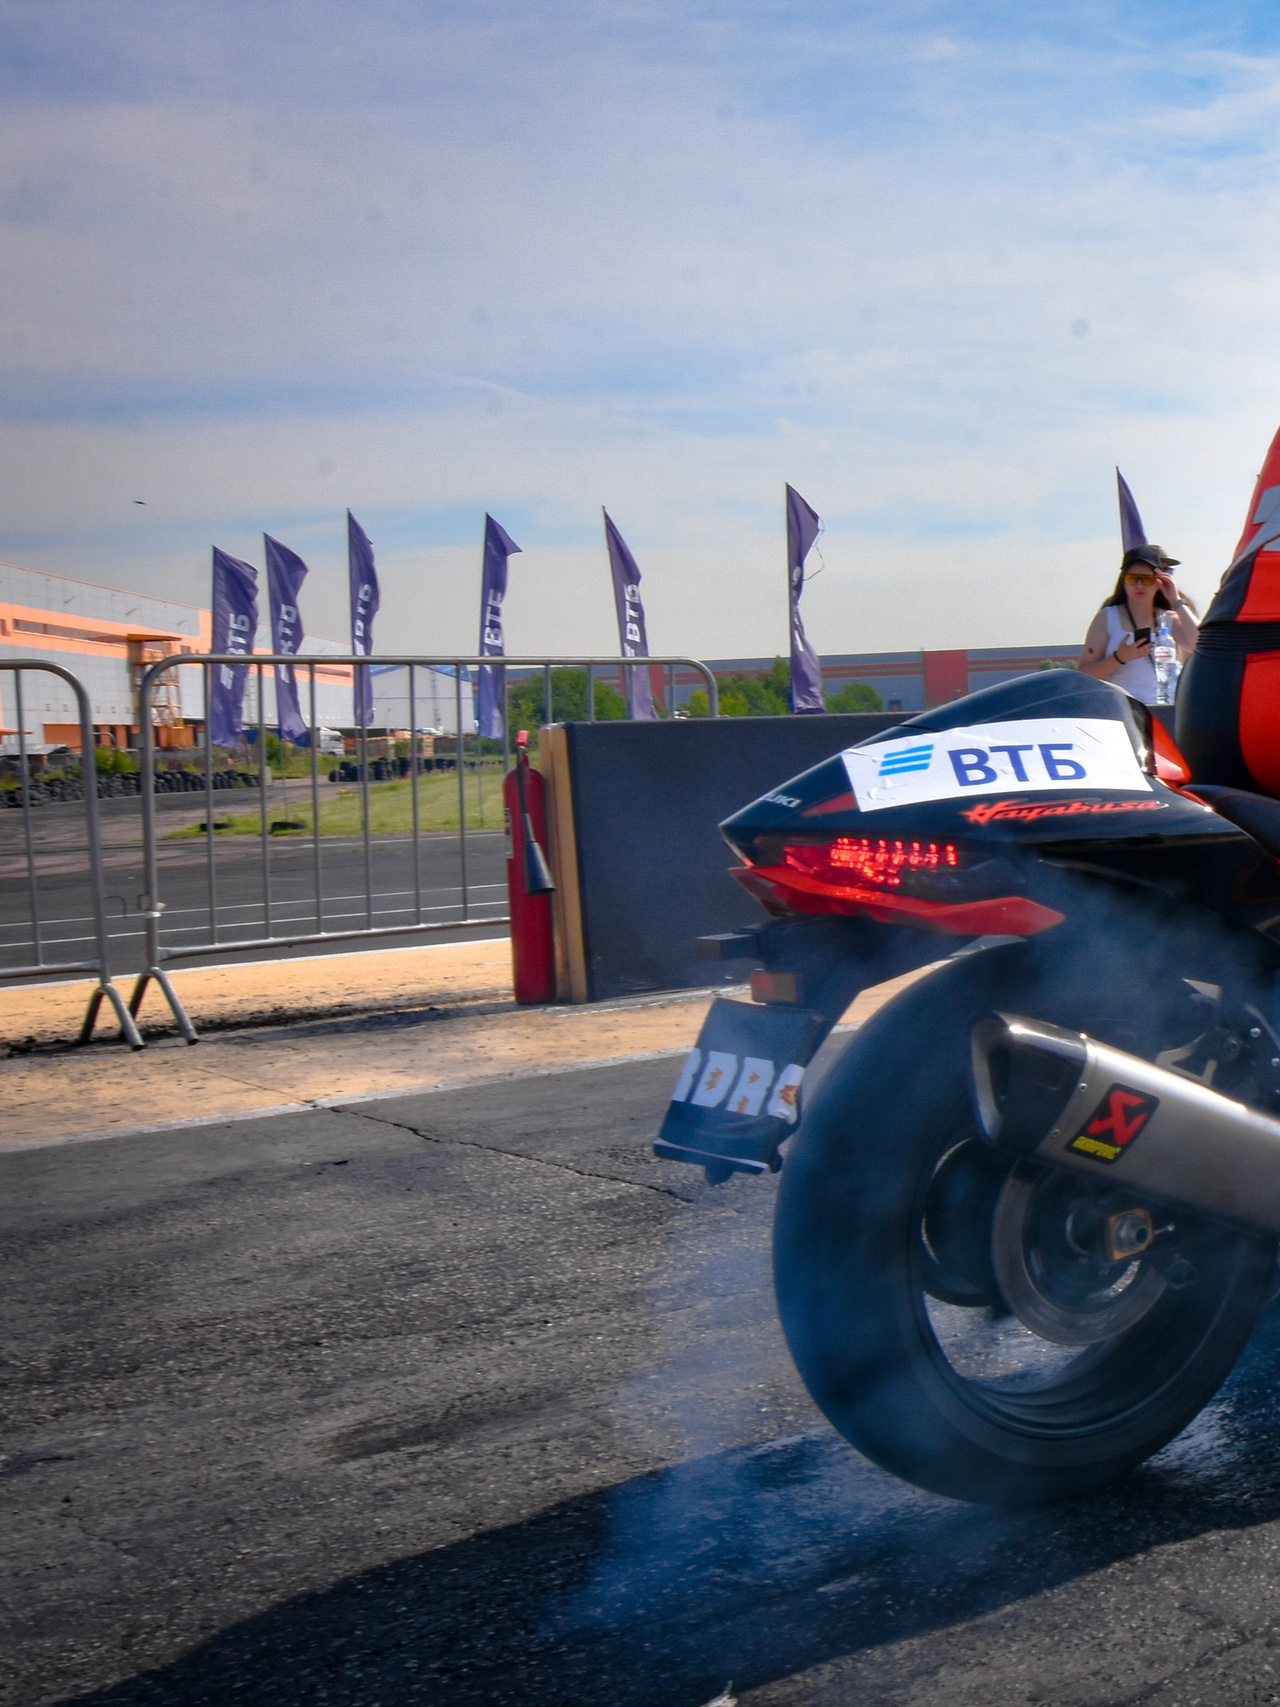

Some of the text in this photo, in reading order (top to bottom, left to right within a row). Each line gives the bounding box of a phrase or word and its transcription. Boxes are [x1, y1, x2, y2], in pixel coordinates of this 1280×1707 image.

[623, 583, 641, 643] ВТБ
[947, 743, 1087, 787] ВТБ
[960, 799, 1168, 826] Hayabusa
